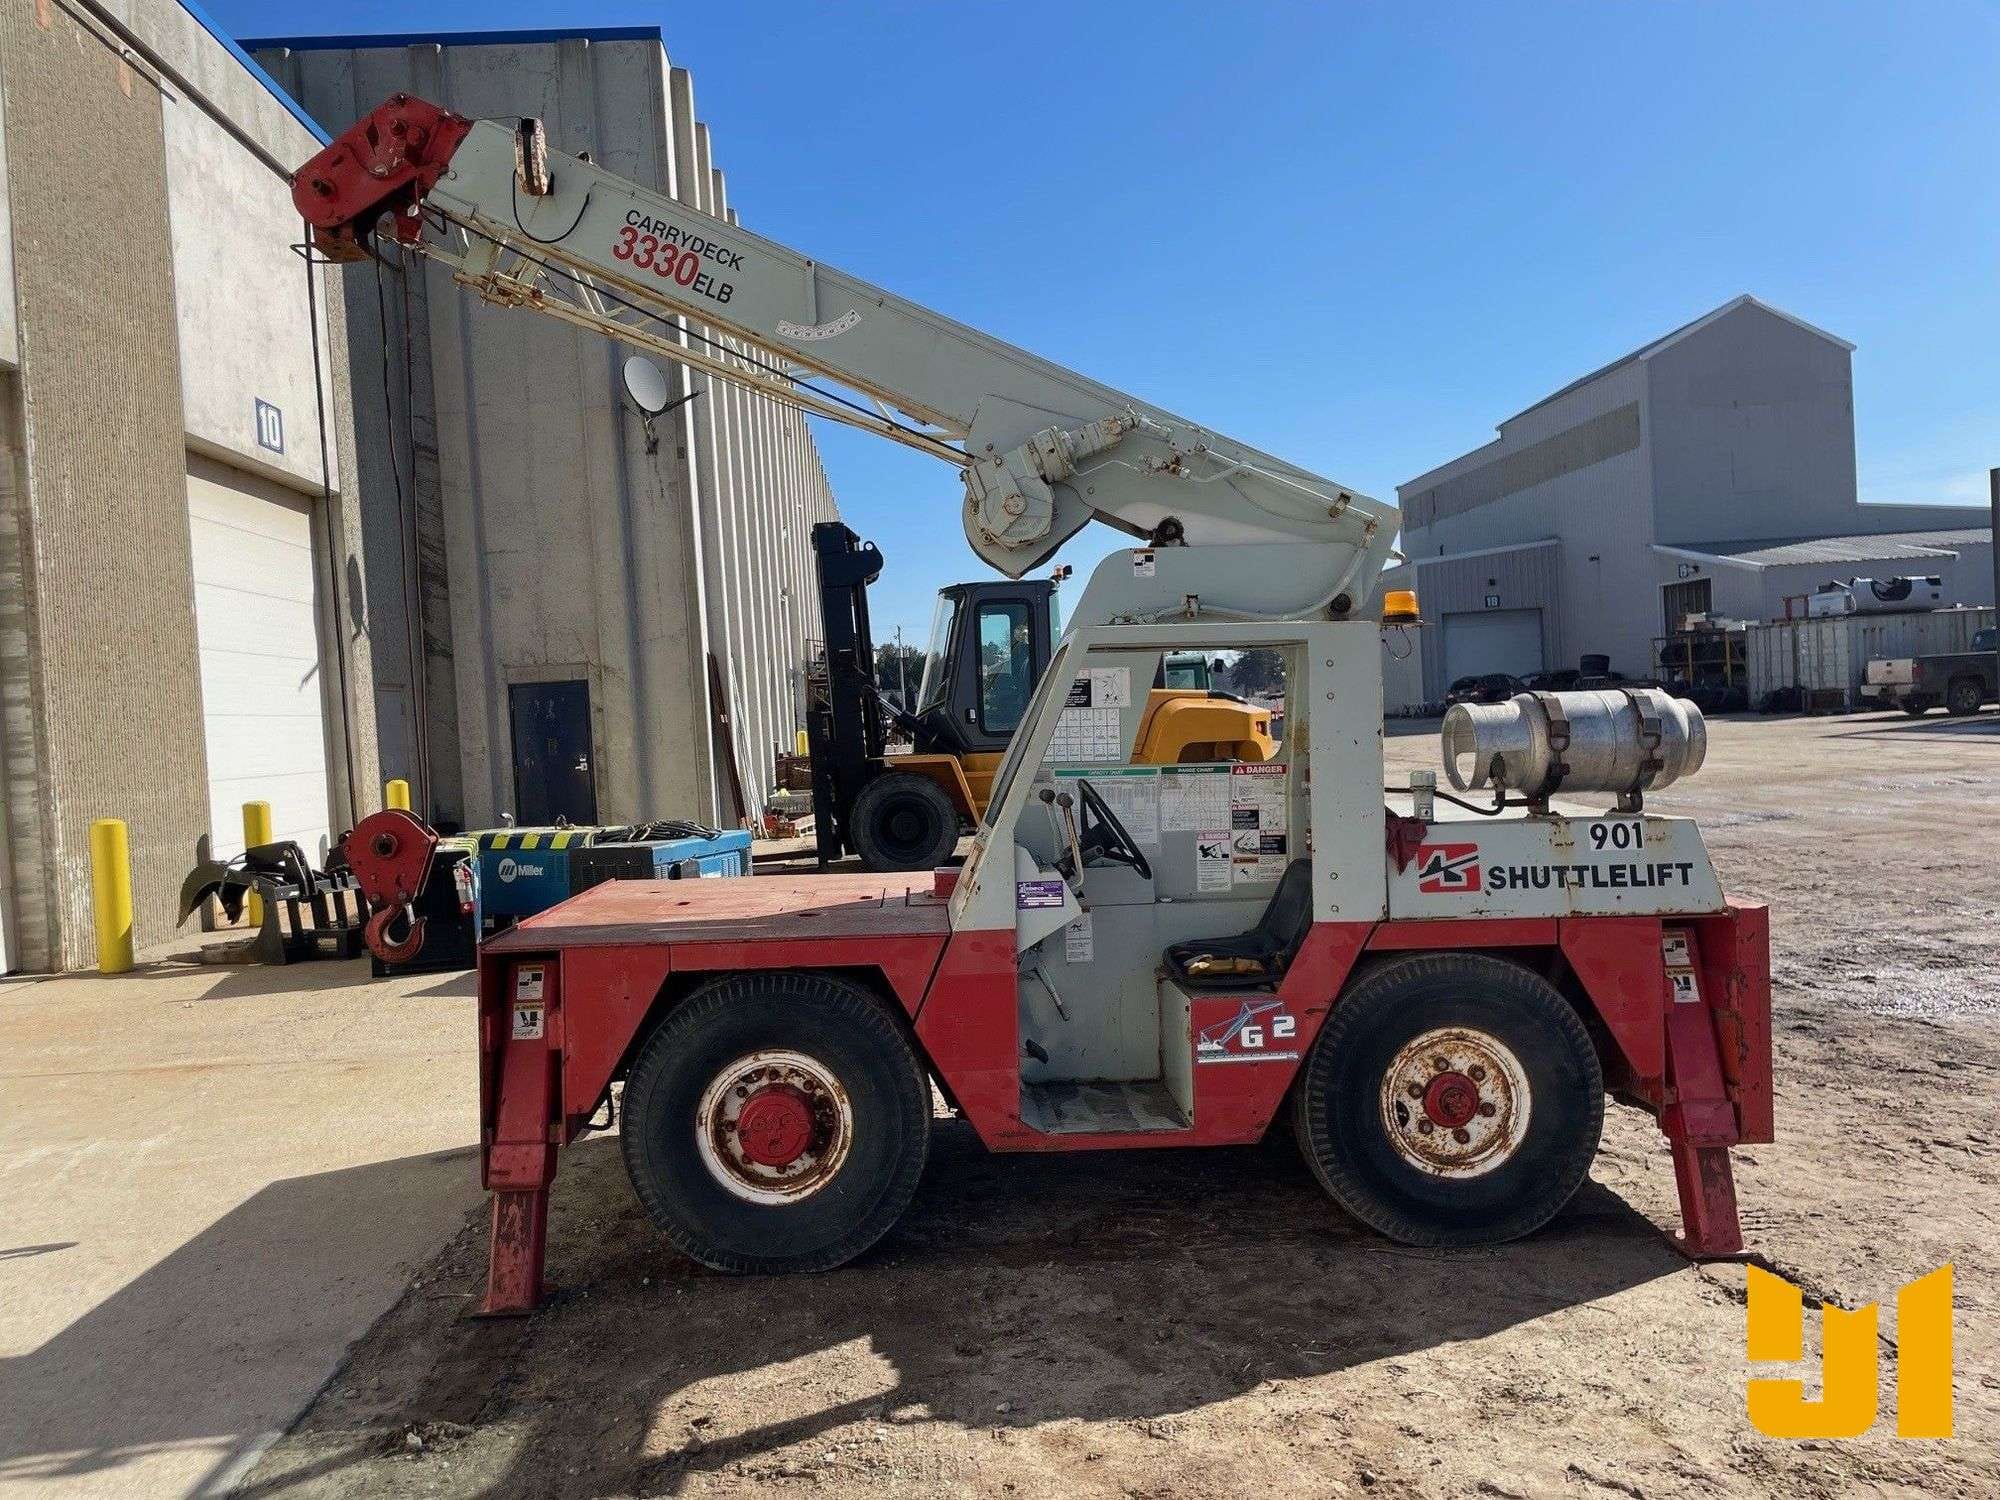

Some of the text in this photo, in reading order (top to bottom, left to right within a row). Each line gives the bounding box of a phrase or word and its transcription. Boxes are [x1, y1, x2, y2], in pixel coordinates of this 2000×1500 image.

[626, 210, 744, 271] CARRYDECK
[259, 404, 281, 448] 10
[1246, 765, 1283, 774] DANGER
[1590, 822, 1643, 849] 901
[518, 864, 544, 876] Miller
[1488, 862, 1693, 890] SHUTTLELIFT
